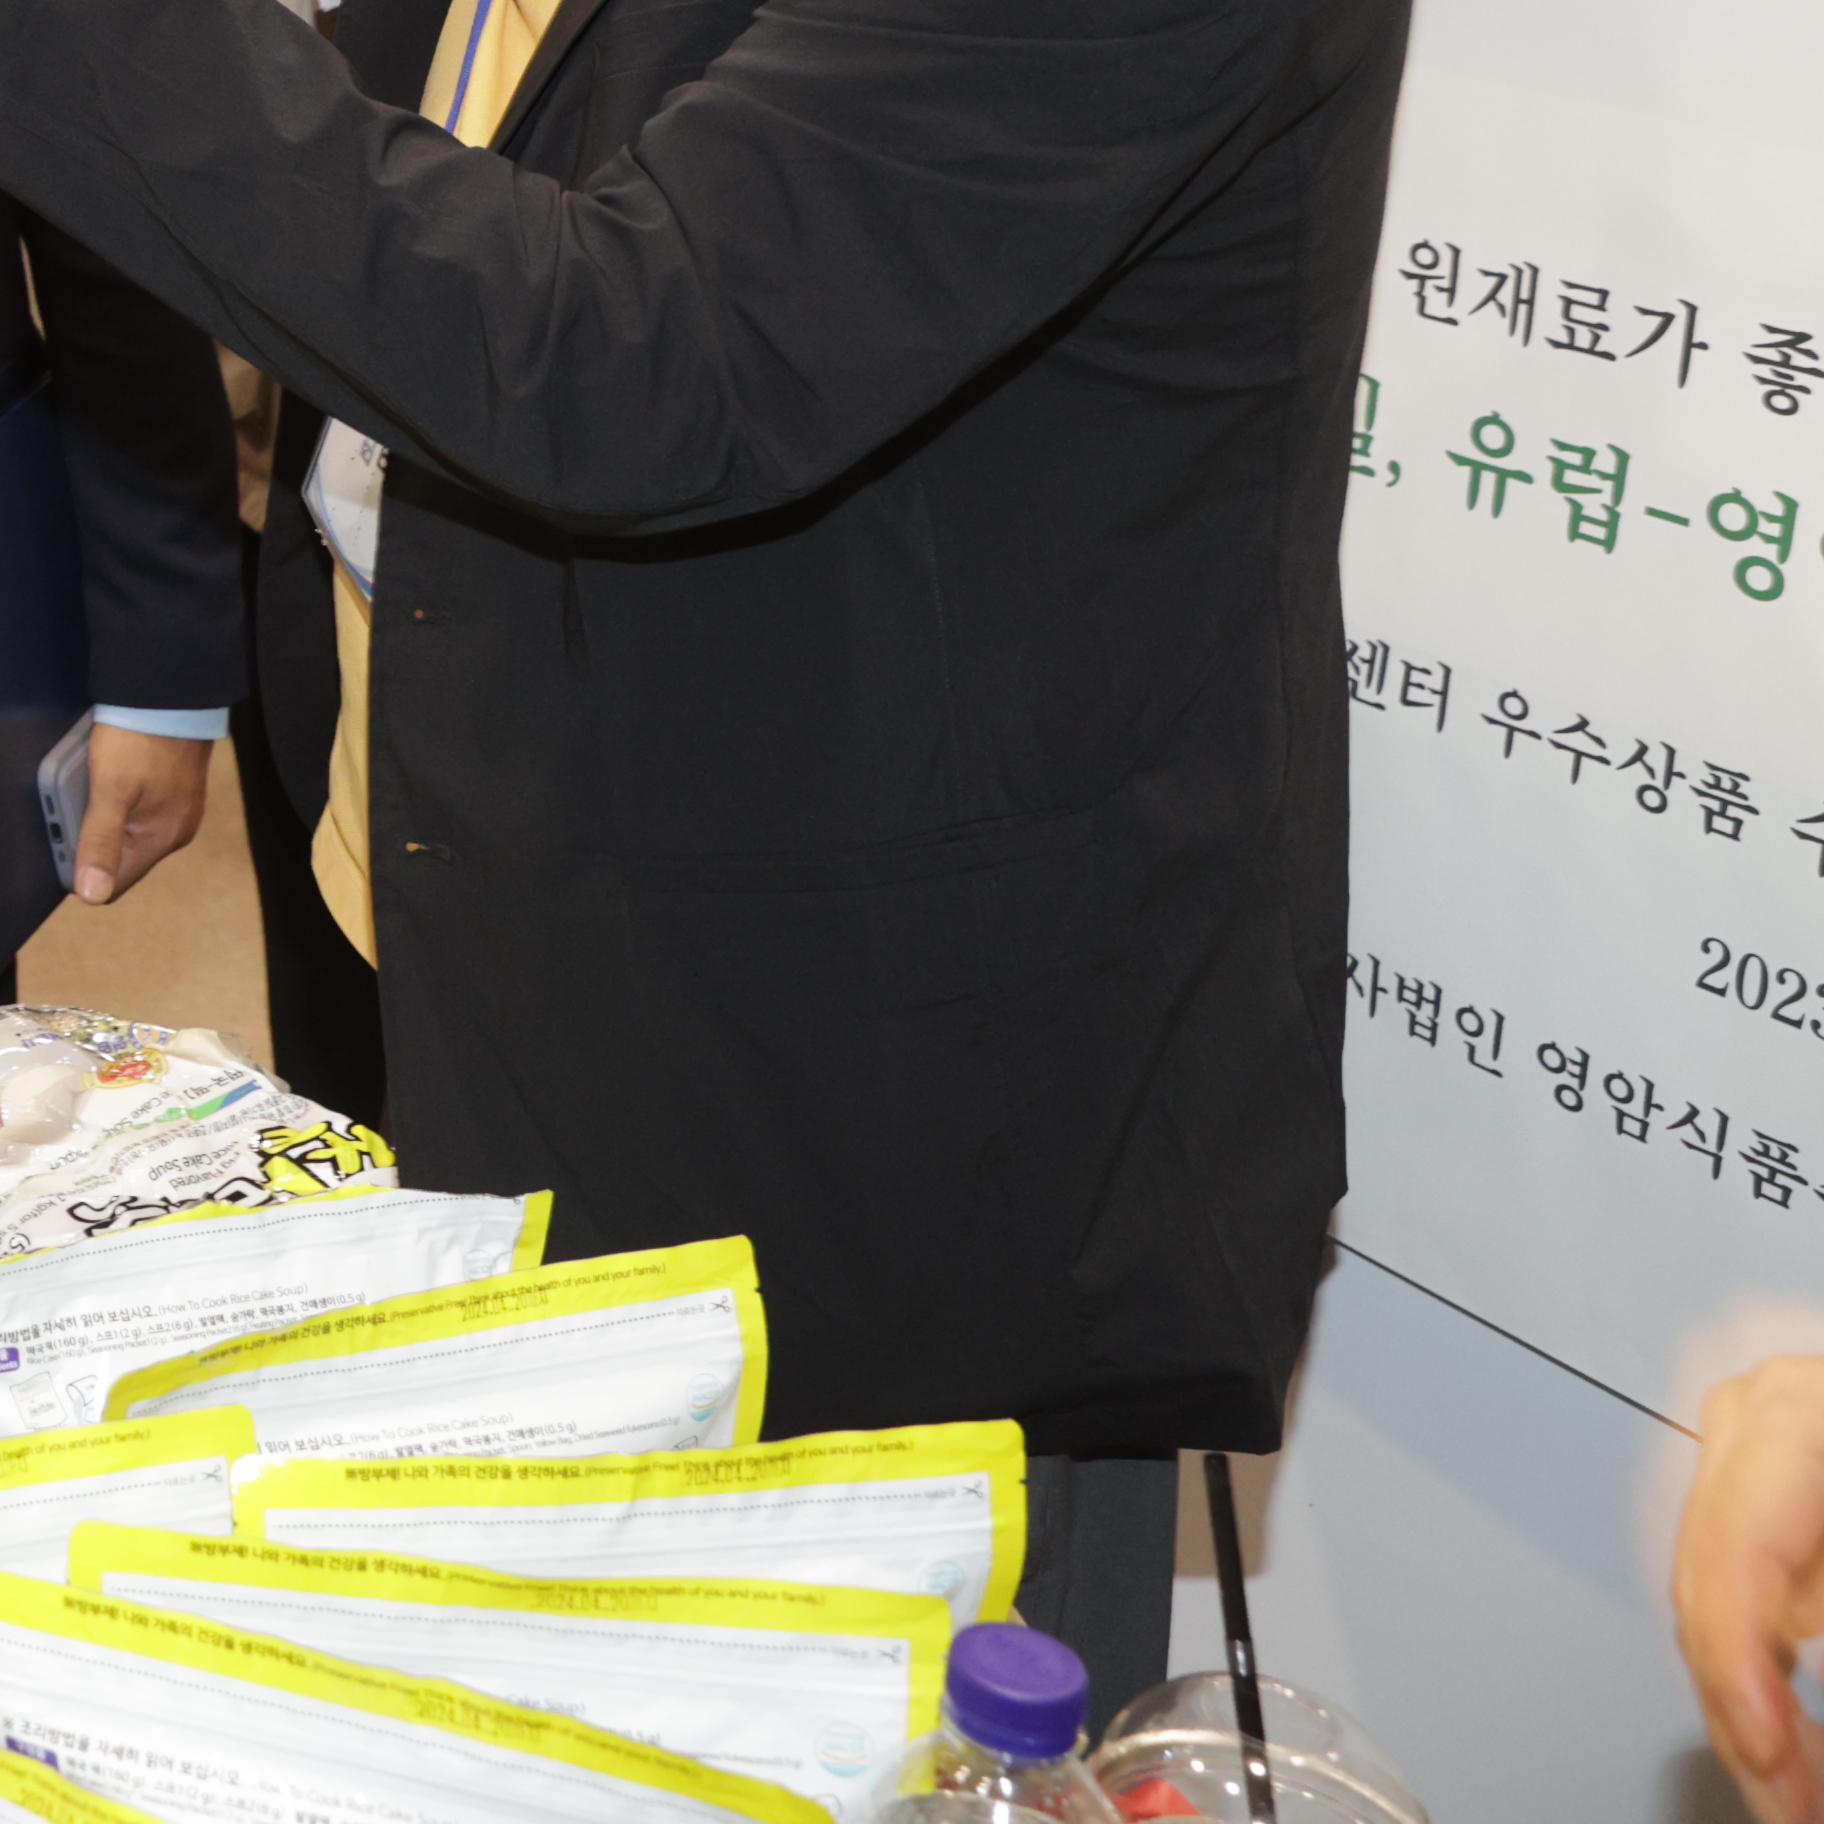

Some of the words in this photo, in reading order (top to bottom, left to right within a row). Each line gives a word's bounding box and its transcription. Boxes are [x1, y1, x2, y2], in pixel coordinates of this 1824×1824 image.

[1398, 239, 1709, 389] 원재료가
[1444, 411, 1824, 602] 유럽-영
[1347, 639, 1452, 733] 센터
[1480, 688, 1761, 842] 우수상품
[1535, 1039, 1824, 1211] 영암식품
[41, 1316, 78, 1334] 자세히
[80, 1311, 106, 1327] 읽어
[107, 1305, 158, 1322] 보십시오.
[158, 1301, 185, 1317] (How
[187, 1299, 201, 1313] To
[202, 1294, 229, 1310] Cook
[230, 1290, 251, 1304] Rice
[252, 1287, 276, 1302] Cake
[276, 1282, 309, 1299] Soup)
[403, 1463, 430, 1480] 나와
[432, 1464, 471, 1480] 가족의
[474, 1464, 512, 1481] 건강을
